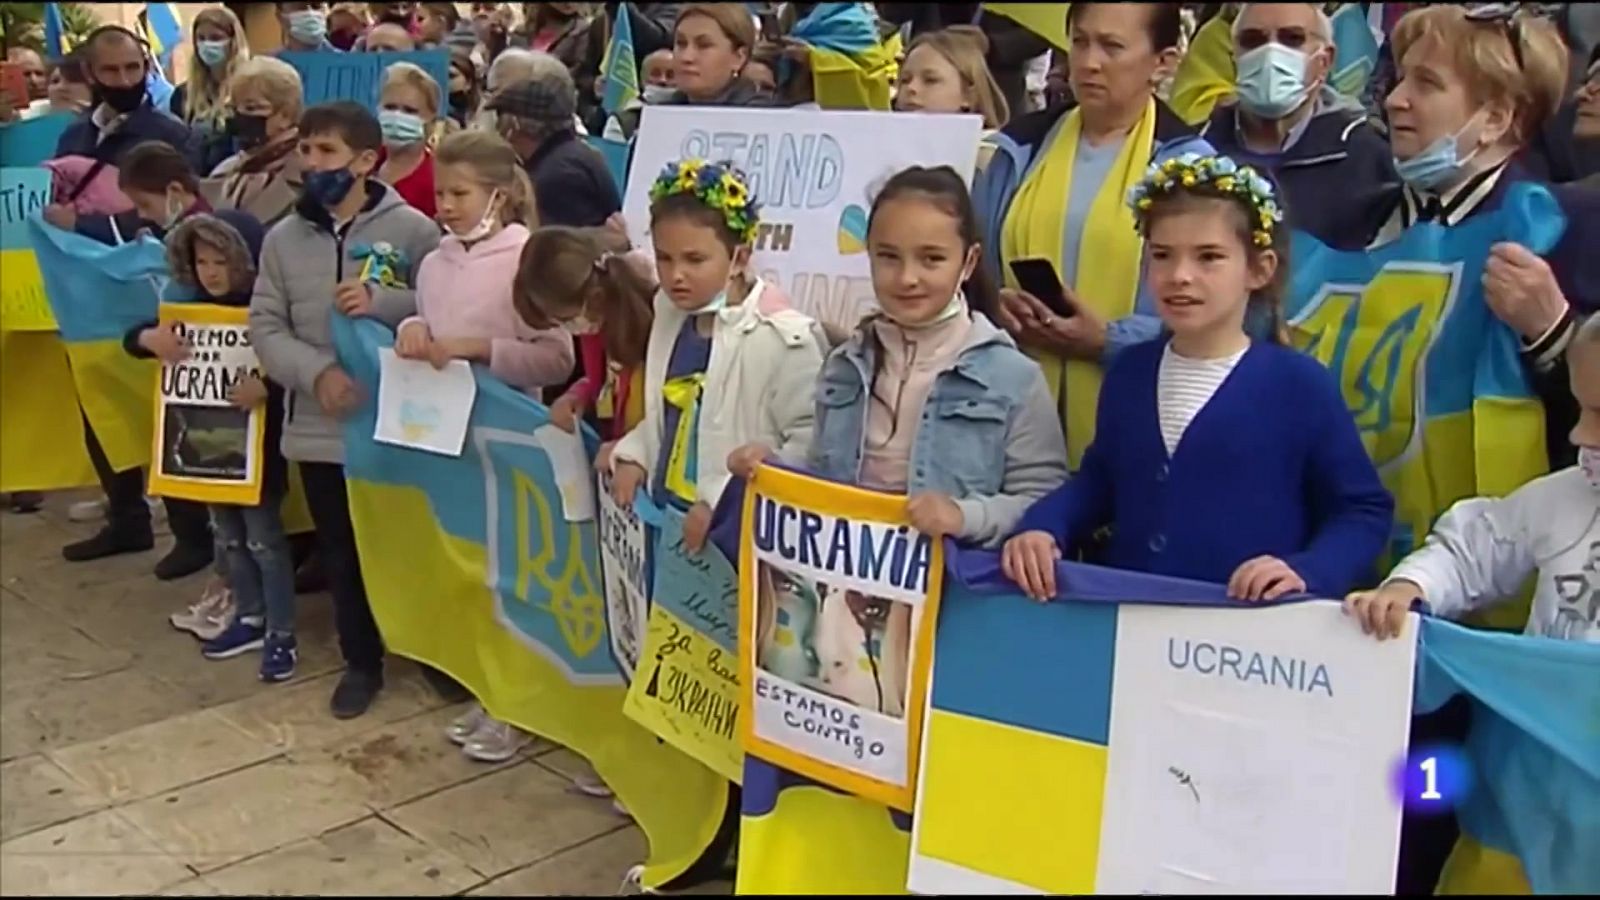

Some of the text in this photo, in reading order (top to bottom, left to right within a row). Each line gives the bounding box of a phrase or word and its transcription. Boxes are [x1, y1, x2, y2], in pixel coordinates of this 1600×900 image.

[161, 365, 261, 400] UCRAN
[1167, 637, 1334, 697] UCRANIA
[756, 677, 861, 730] ESTAMOS
